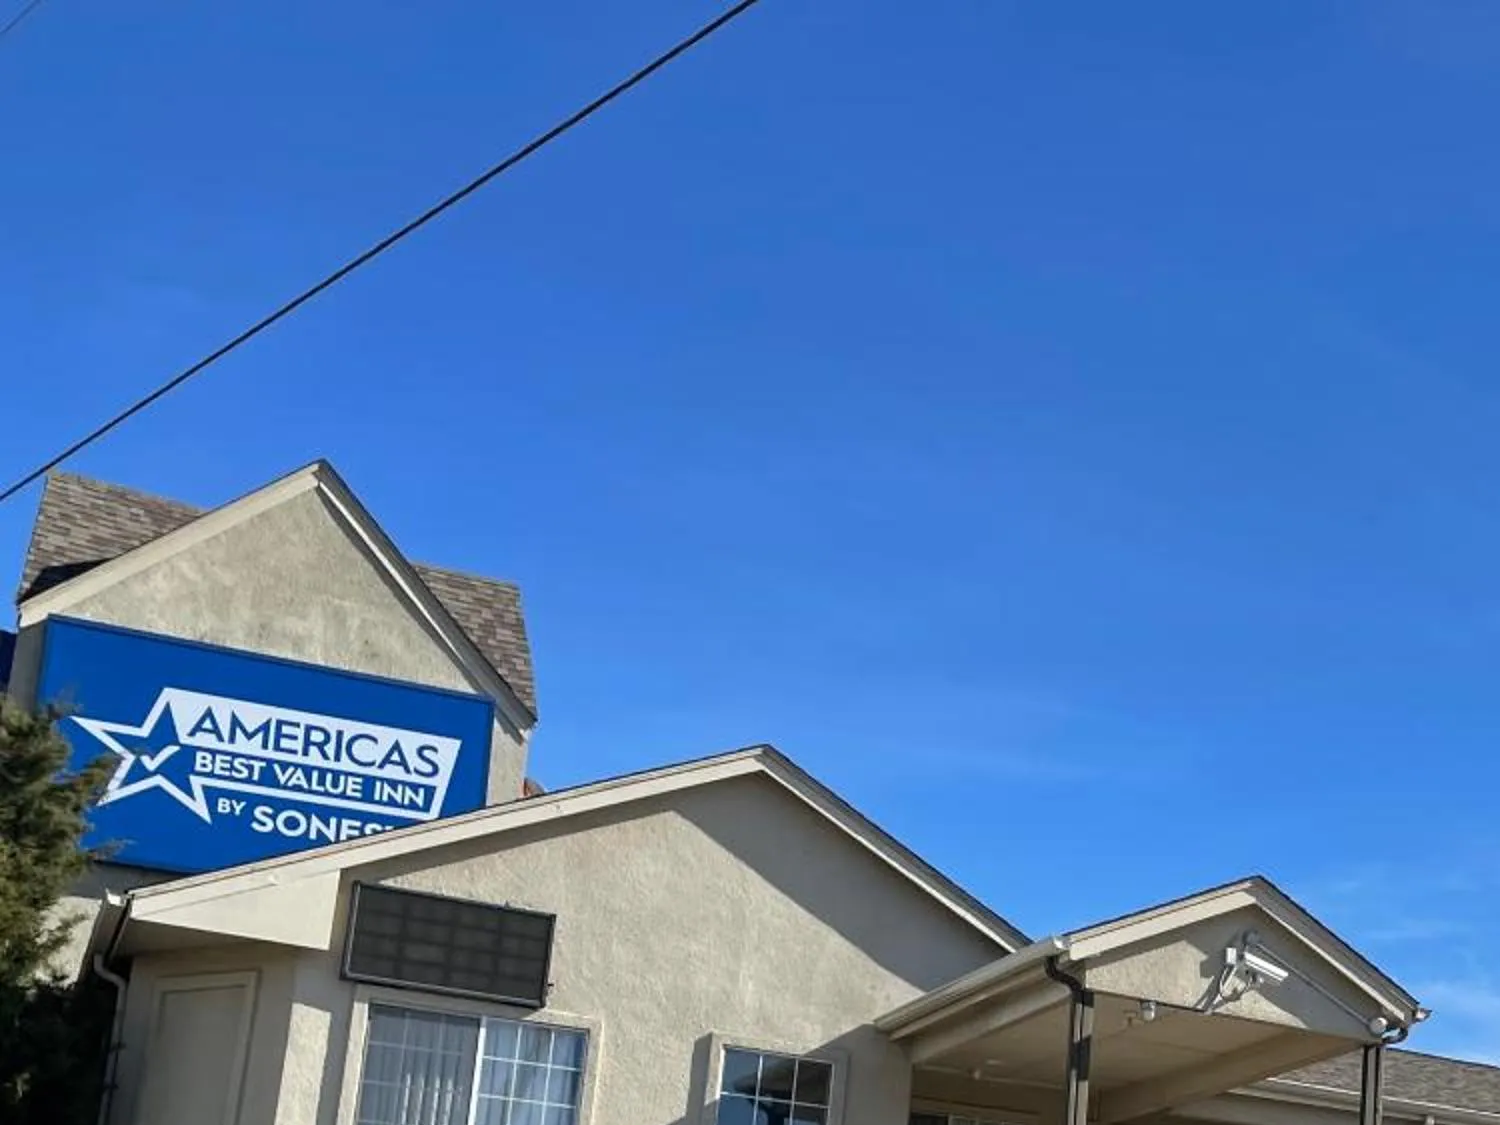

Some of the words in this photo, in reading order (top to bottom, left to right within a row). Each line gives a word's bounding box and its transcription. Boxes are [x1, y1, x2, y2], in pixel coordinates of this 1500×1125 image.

[187, 705, 441, 778] AMERICAS
[194, 752, 267, 783] BEST
[273, 763, 362, 799] VALUE
[373, 781, 426, 808] INN
[217, 797, 247, 816] BY
